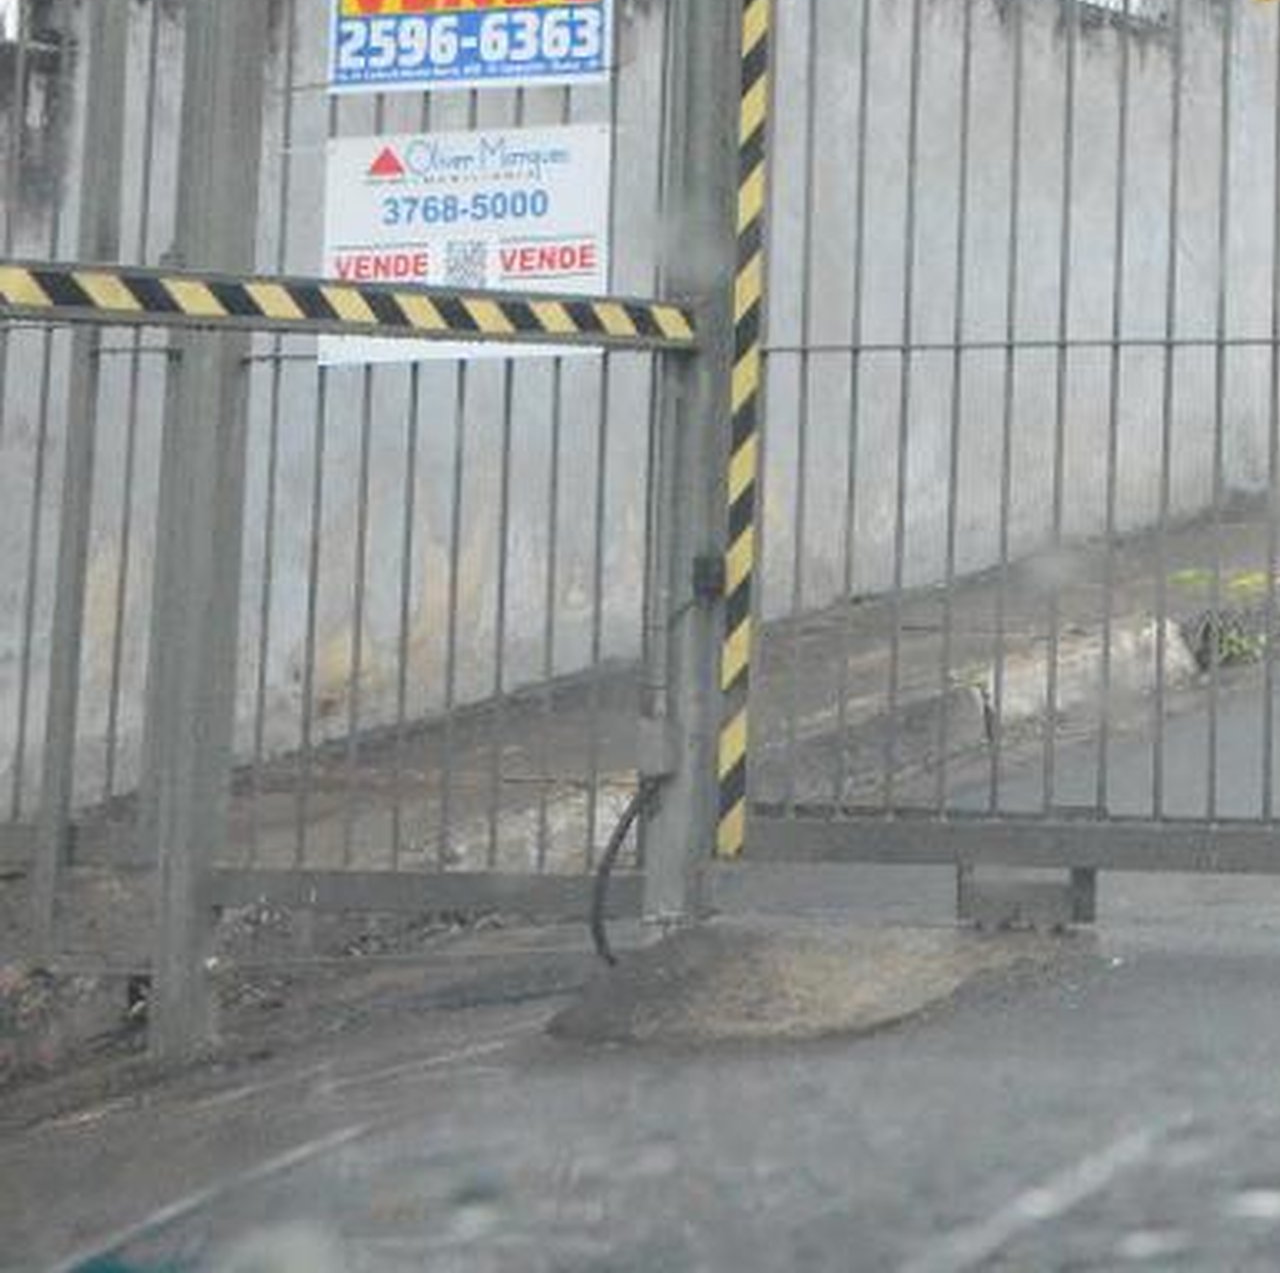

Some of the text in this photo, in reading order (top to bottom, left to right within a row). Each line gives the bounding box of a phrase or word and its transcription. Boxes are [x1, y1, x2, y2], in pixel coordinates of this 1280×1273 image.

[338, 6, 601, 70] 2596-6363
[382, 189, 549, 225] 3768-5000
[335, 244, 596, 279] VENDE VENDE
